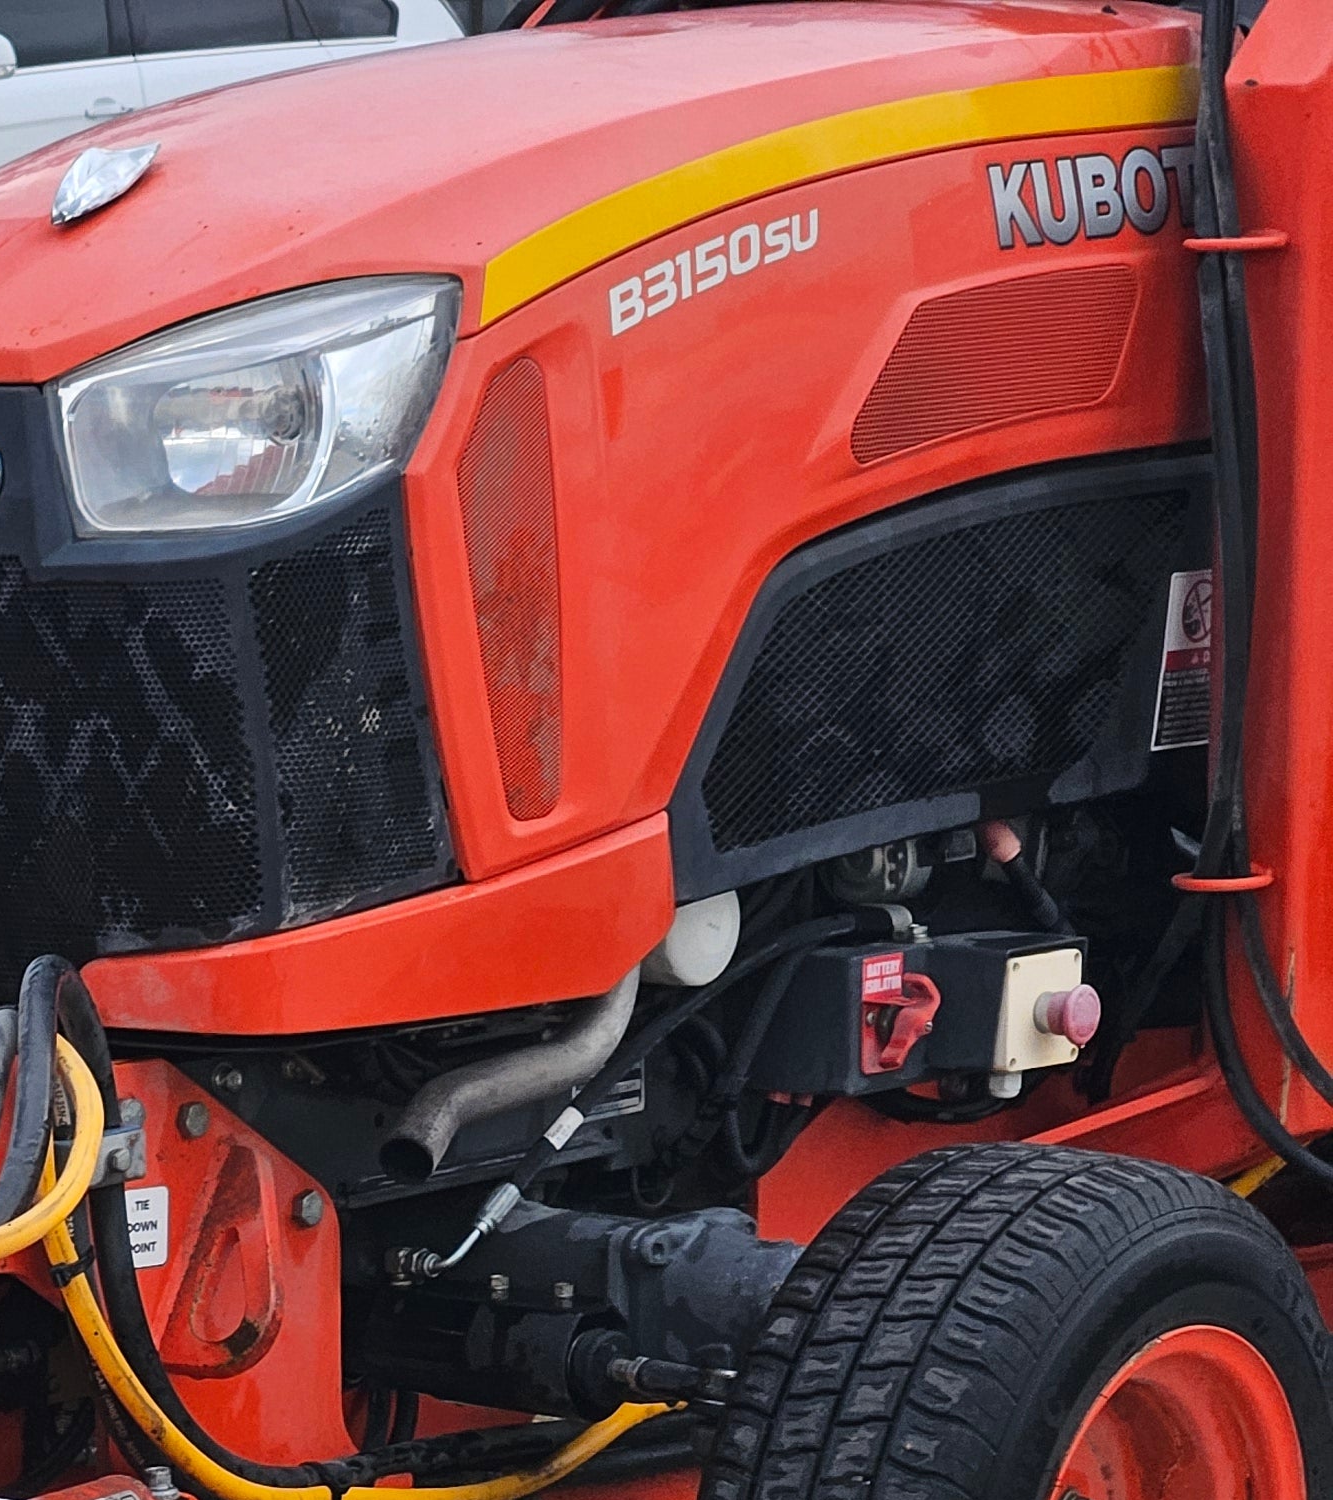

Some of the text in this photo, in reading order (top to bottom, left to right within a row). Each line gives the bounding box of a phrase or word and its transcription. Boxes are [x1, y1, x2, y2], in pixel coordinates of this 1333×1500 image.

[986, 145, 1196, 250] KUBOT
[609, 208, 819, 337] B3150SU
[135, 1199, 150, 1211] TIE
[127, 1220, 158, 1234] DOWN
[130, 1241, 157, 1254] OINT
